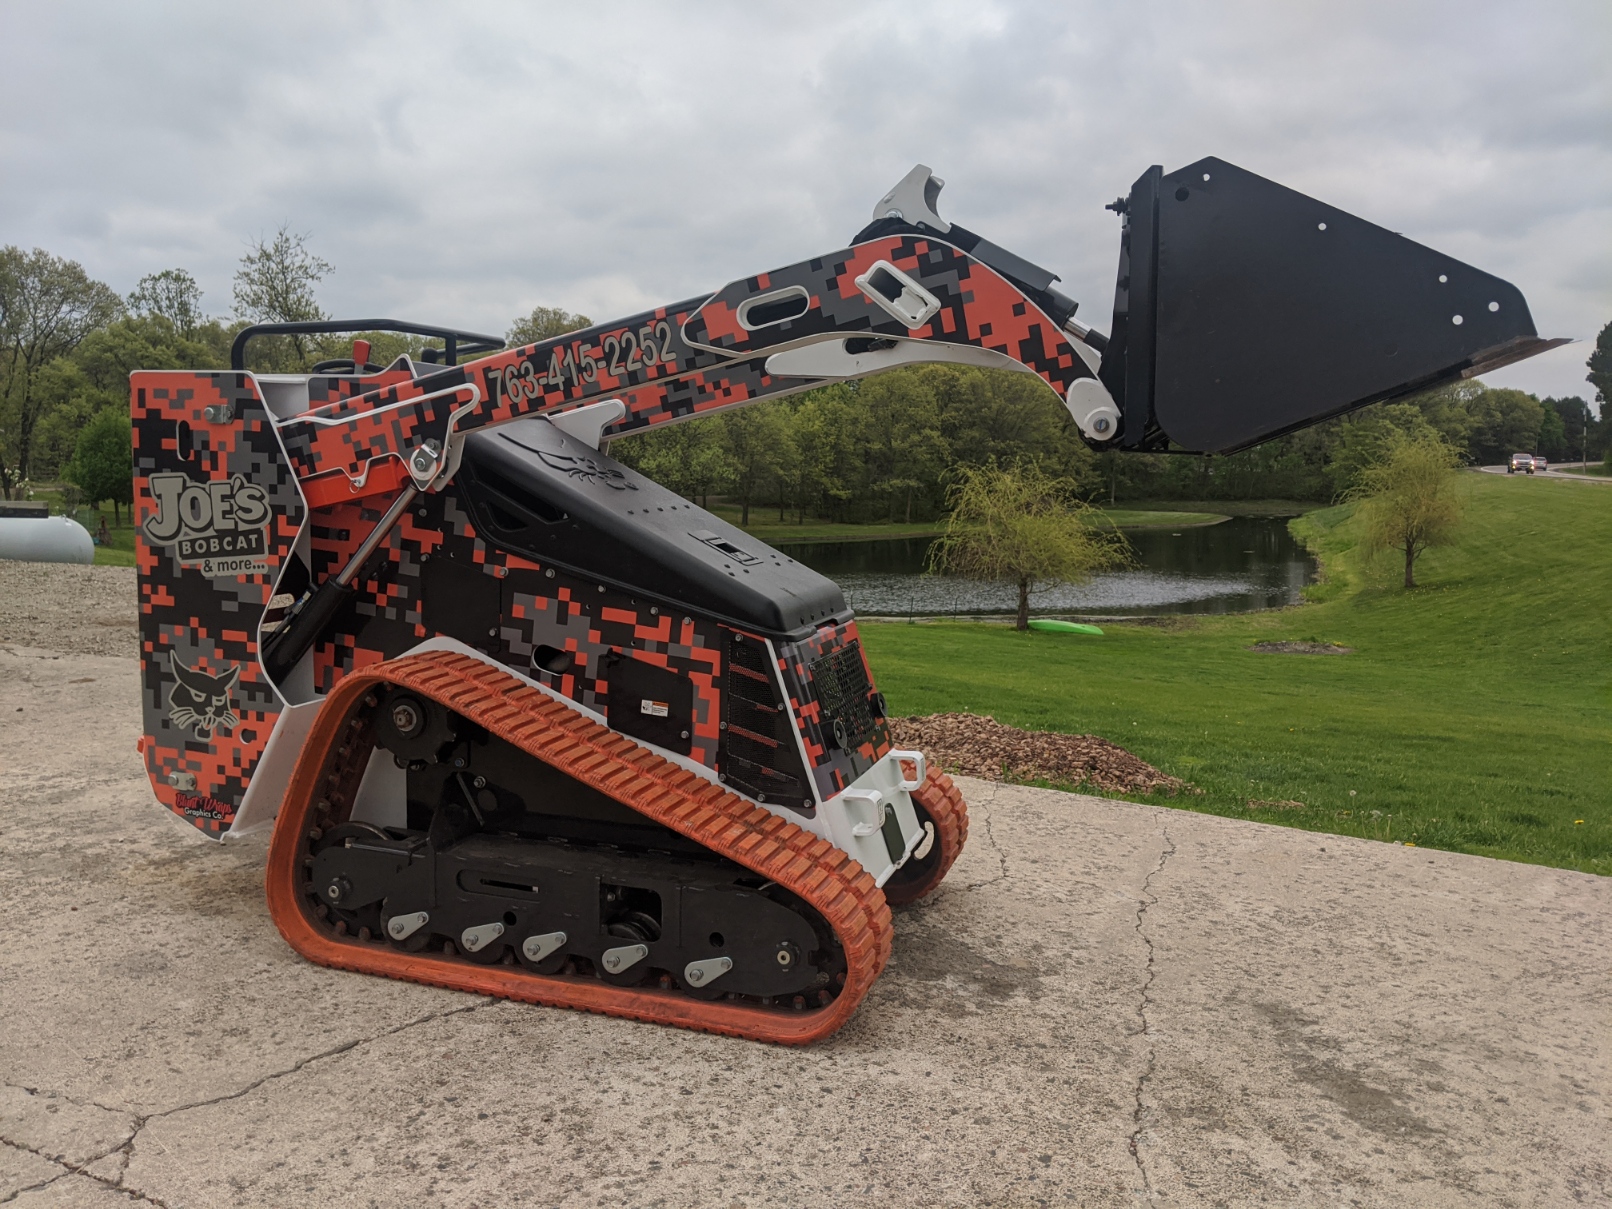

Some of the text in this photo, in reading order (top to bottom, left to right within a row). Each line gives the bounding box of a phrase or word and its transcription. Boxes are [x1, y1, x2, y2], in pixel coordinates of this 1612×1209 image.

[488, 321, 677, 408] 763-415-2252
[145, 474, 270, 541] JOE'S
[181, 533, 259, 555] BOBCAT
[203, 559, 266, 573] & more...
[184, 807, 224, 819] Graphics Co.
